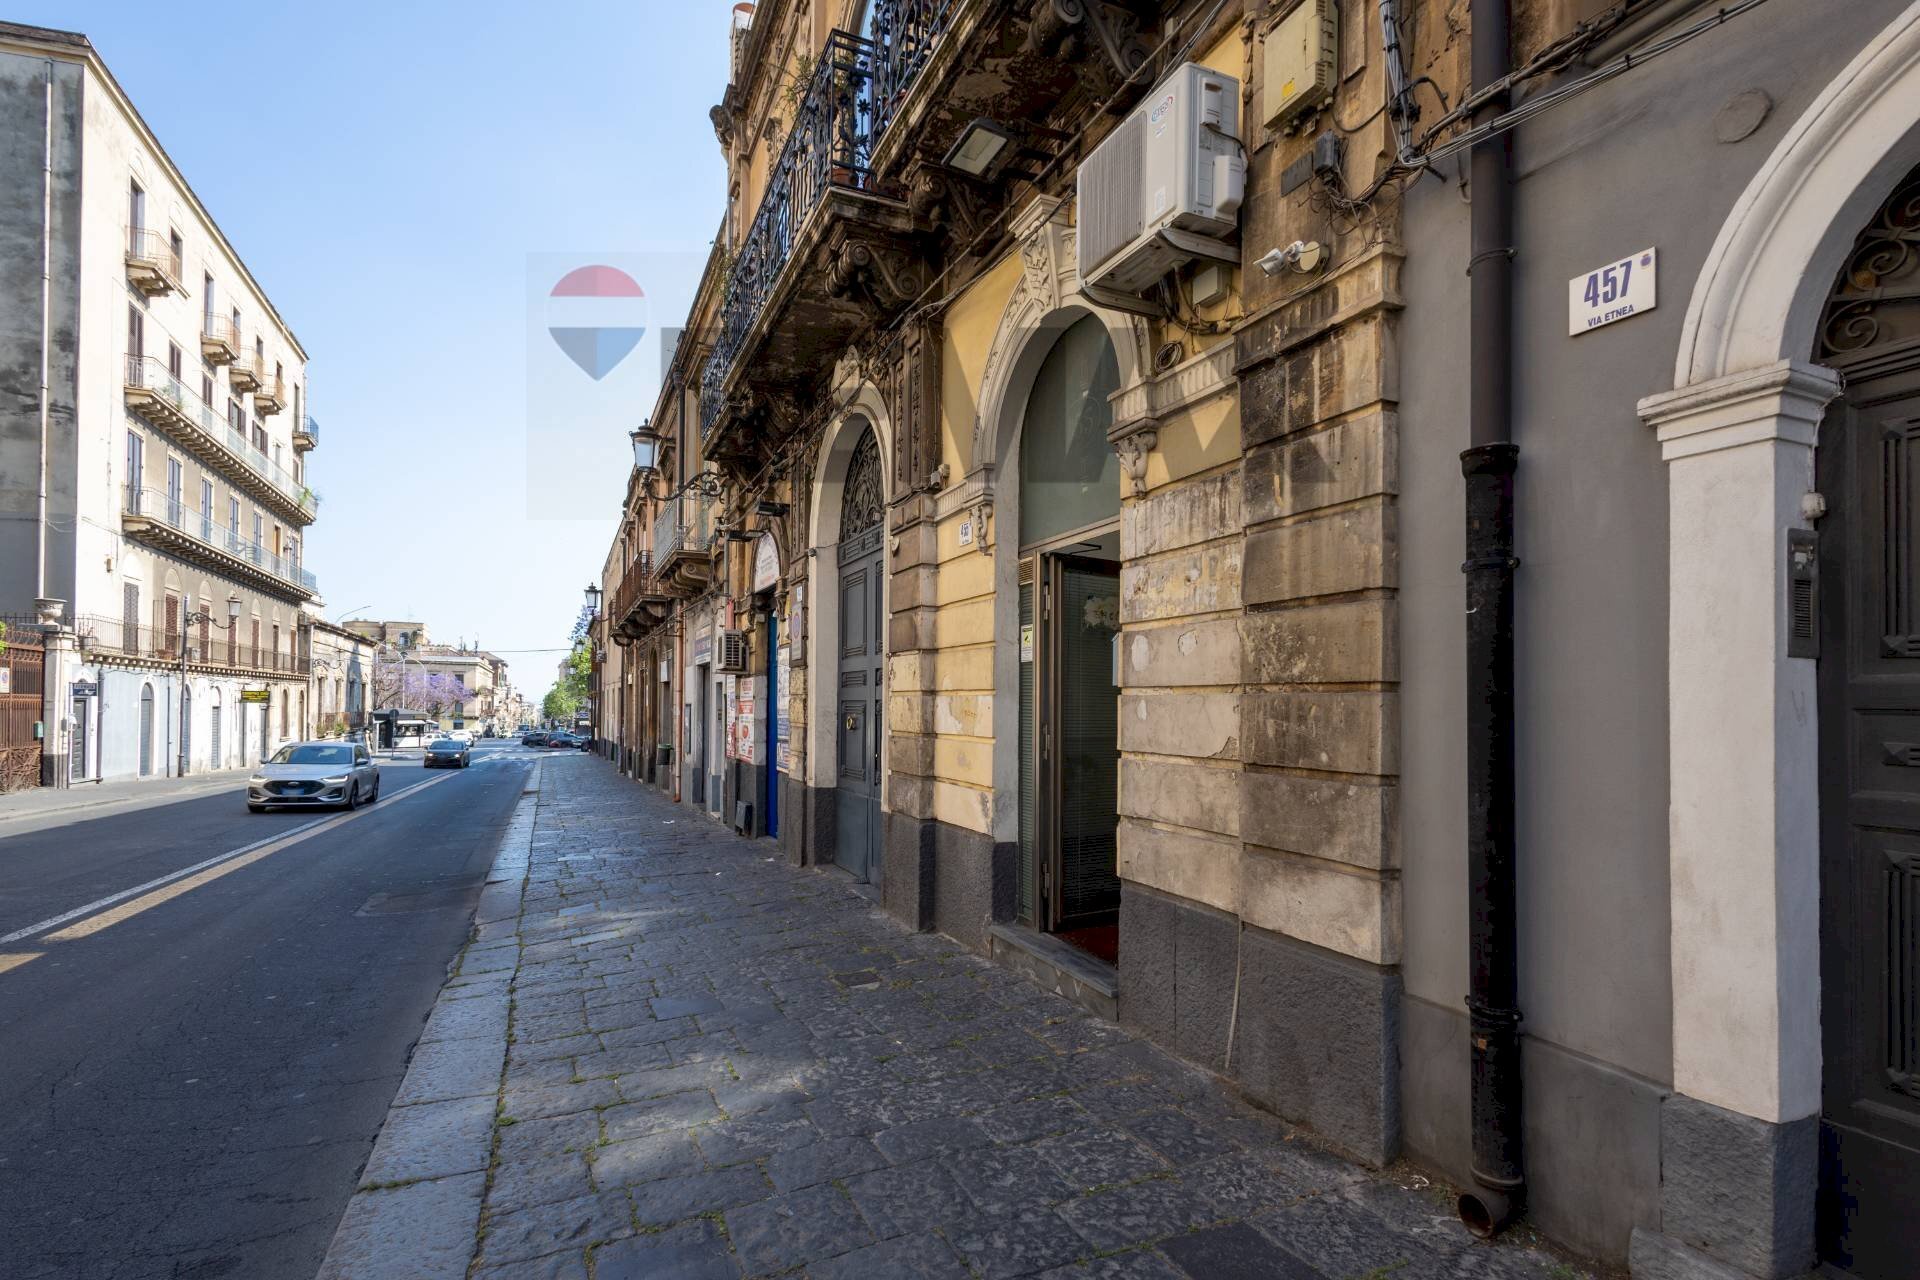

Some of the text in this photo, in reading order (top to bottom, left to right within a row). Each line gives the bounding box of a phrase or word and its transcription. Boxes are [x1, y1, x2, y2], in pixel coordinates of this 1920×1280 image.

[1584, 260, 1632, 308] 457
[1588, 304, 1634, 327] VIA ETNEA
